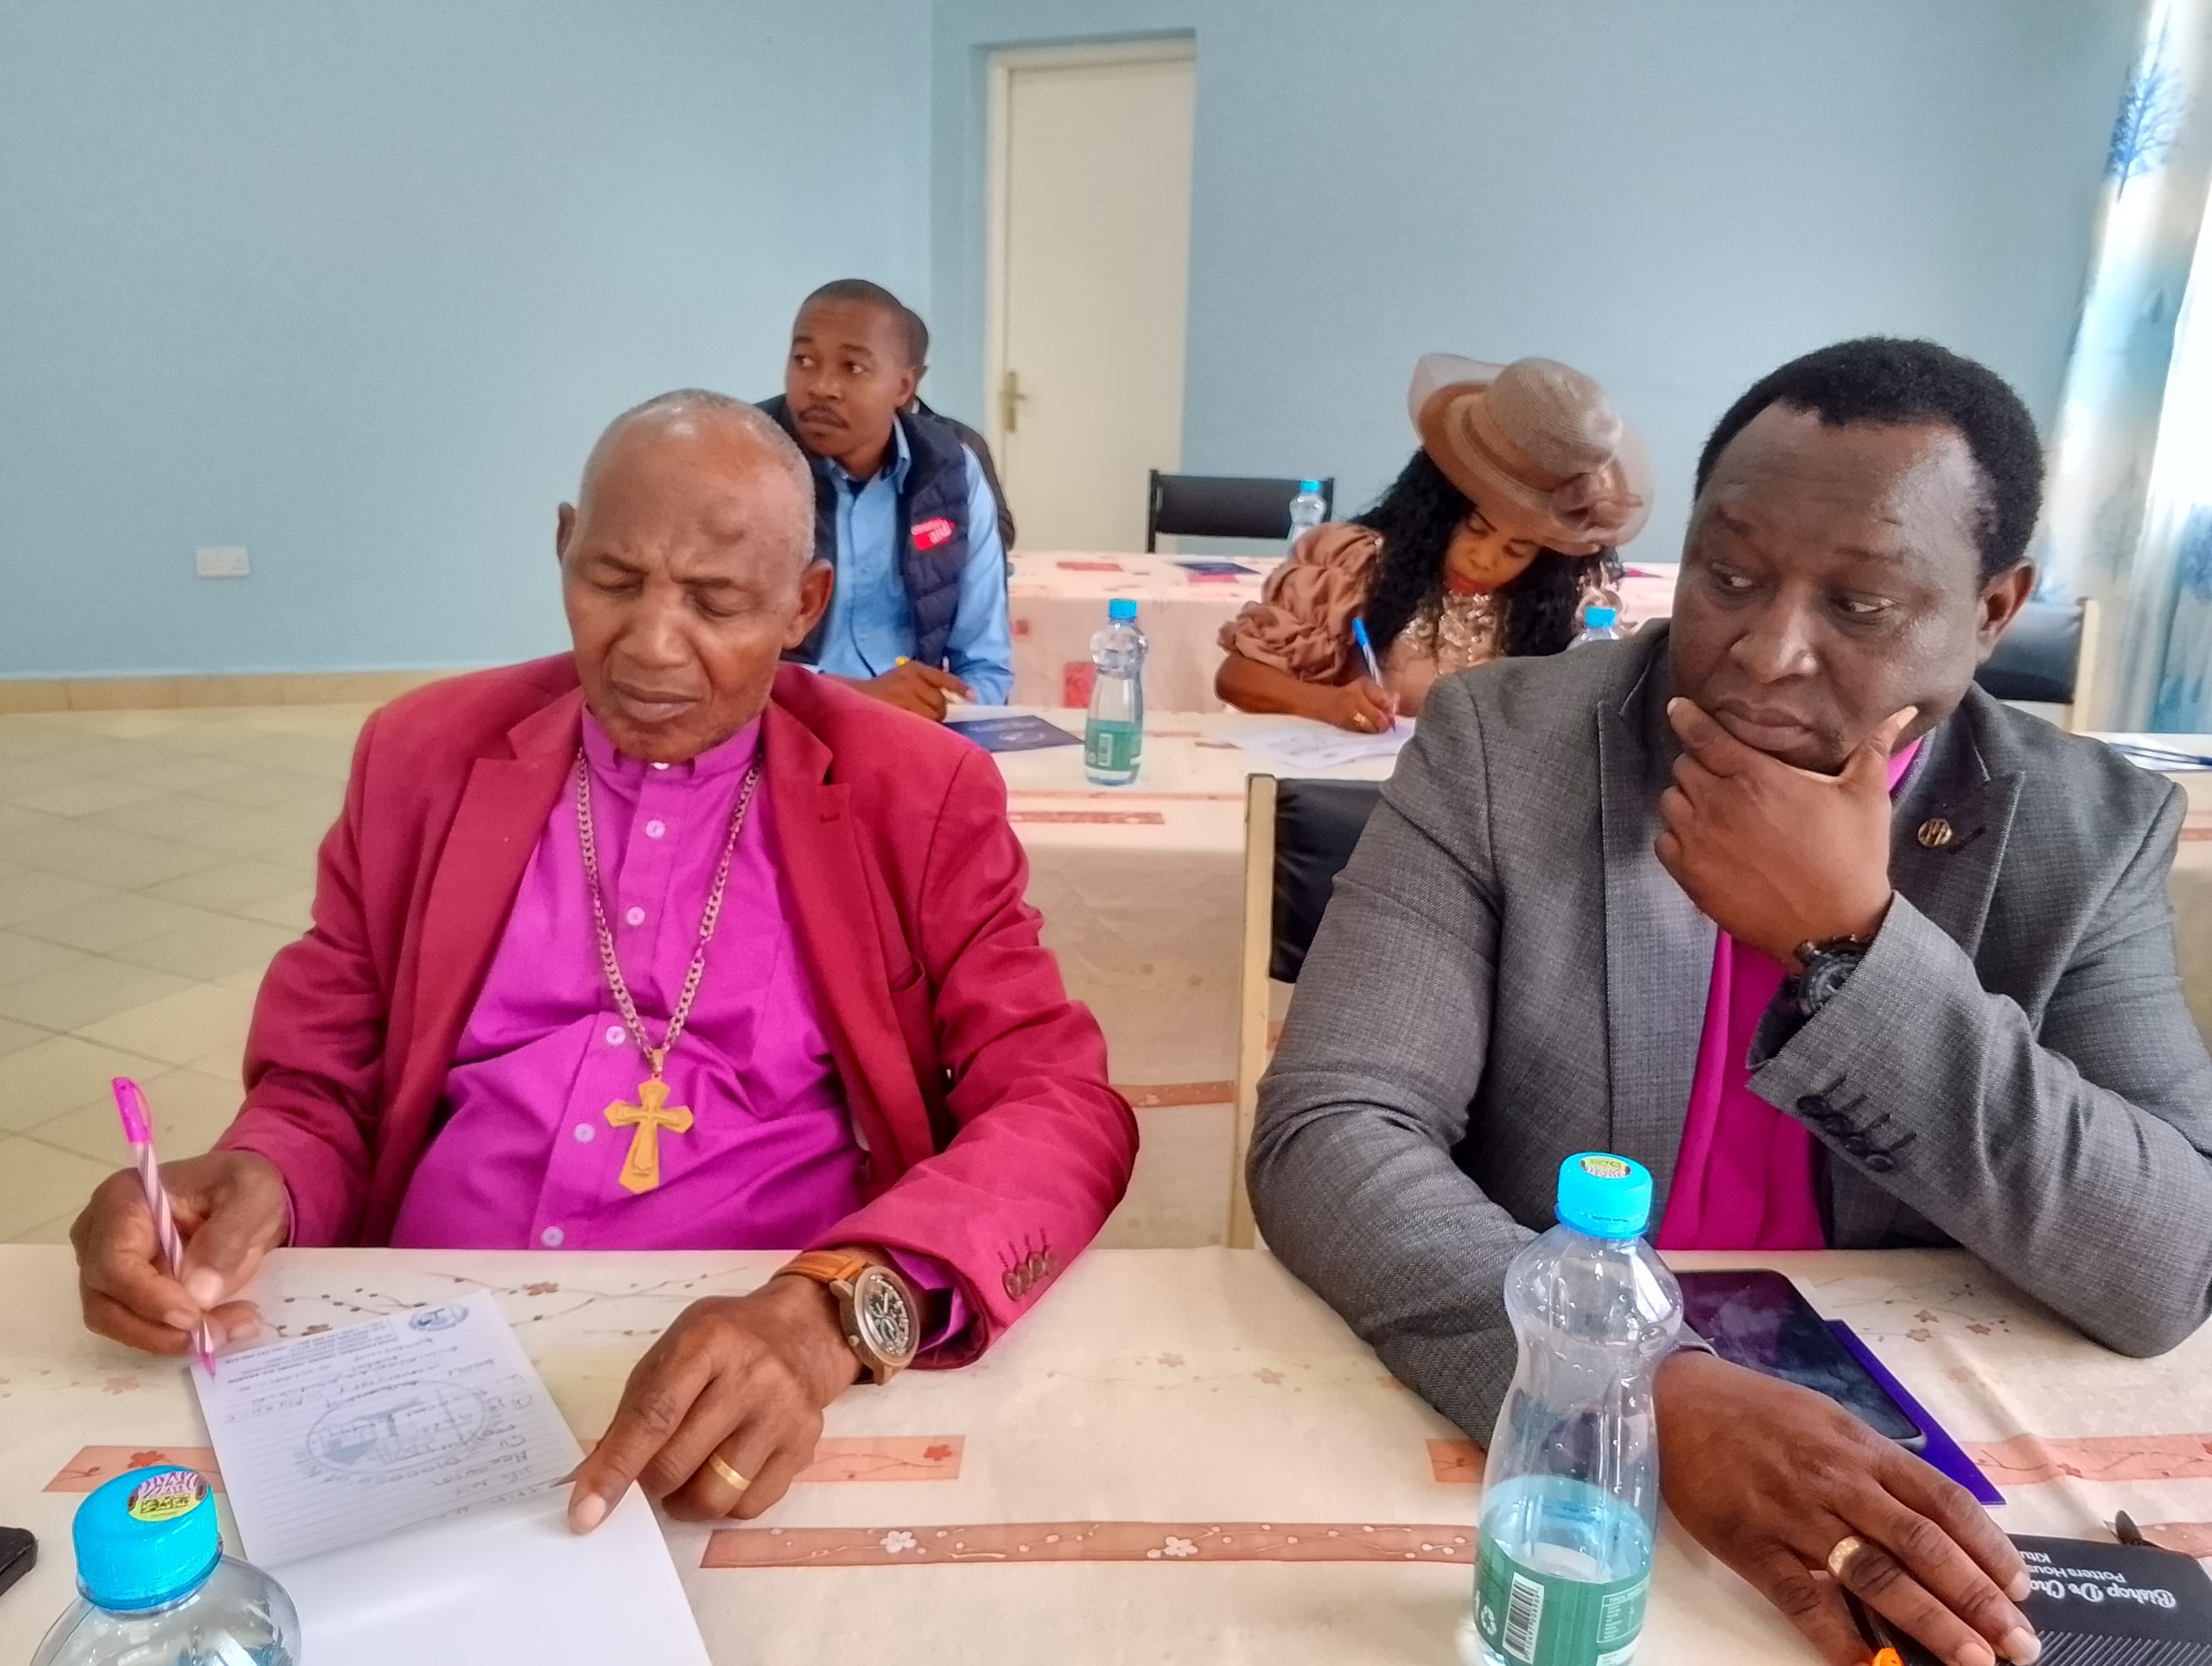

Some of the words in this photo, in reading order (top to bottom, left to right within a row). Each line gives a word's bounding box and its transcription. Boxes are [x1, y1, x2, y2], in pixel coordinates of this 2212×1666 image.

[2019, 1551, 2051, 1563] Kitu
[2026, 1565, 2067, 1578] Hous
[2068, 1567, 2127, 1583] Potters
[2107, 1583, 2177, 1608] Bishop
